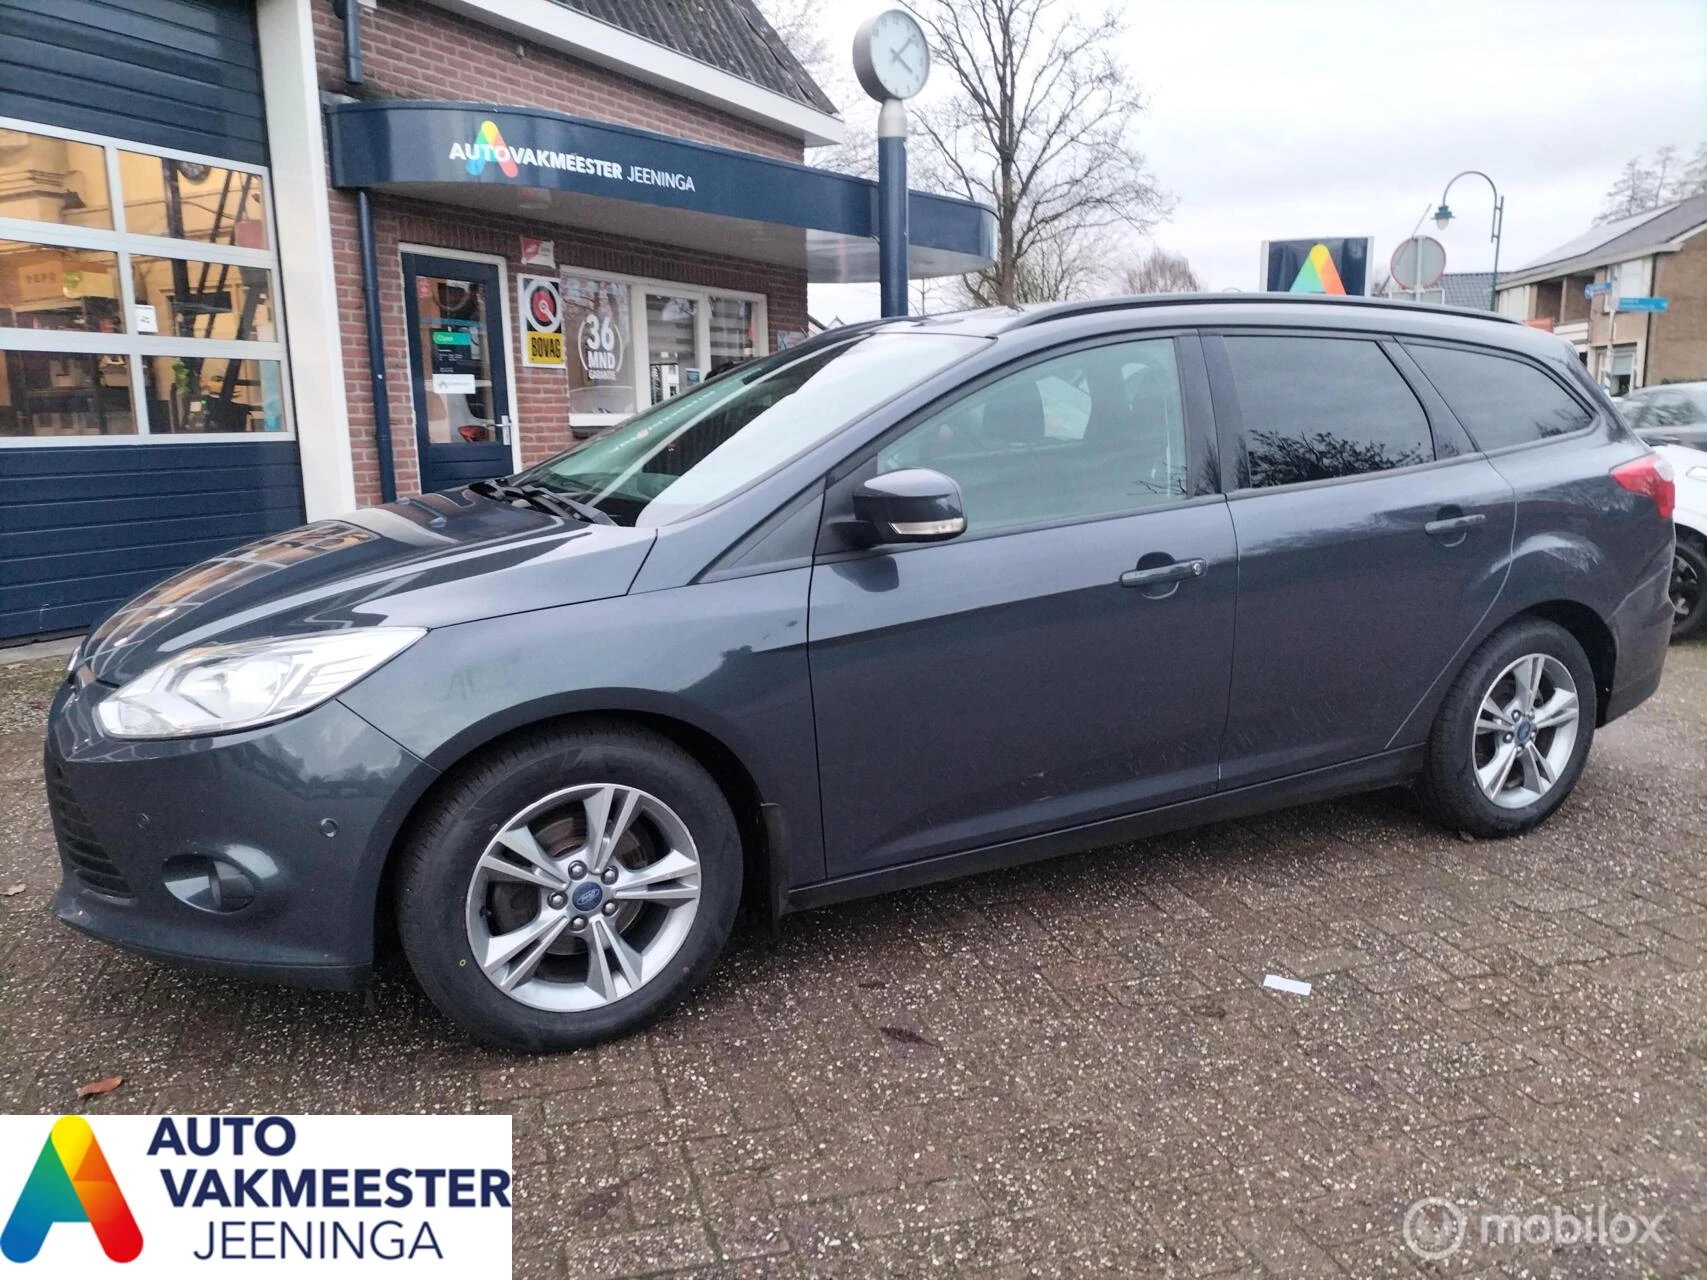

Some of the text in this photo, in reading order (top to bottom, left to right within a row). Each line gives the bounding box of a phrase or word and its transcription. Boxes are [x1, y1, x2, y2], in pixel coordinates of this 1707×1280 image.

[449, 142, 696, 192] AUTOVAKMEESTER JEENINGA
[531, 336, 561, 358] BOVAG
[586, 314, 615, 351] 36
[588, 351, 615, 369] MND
